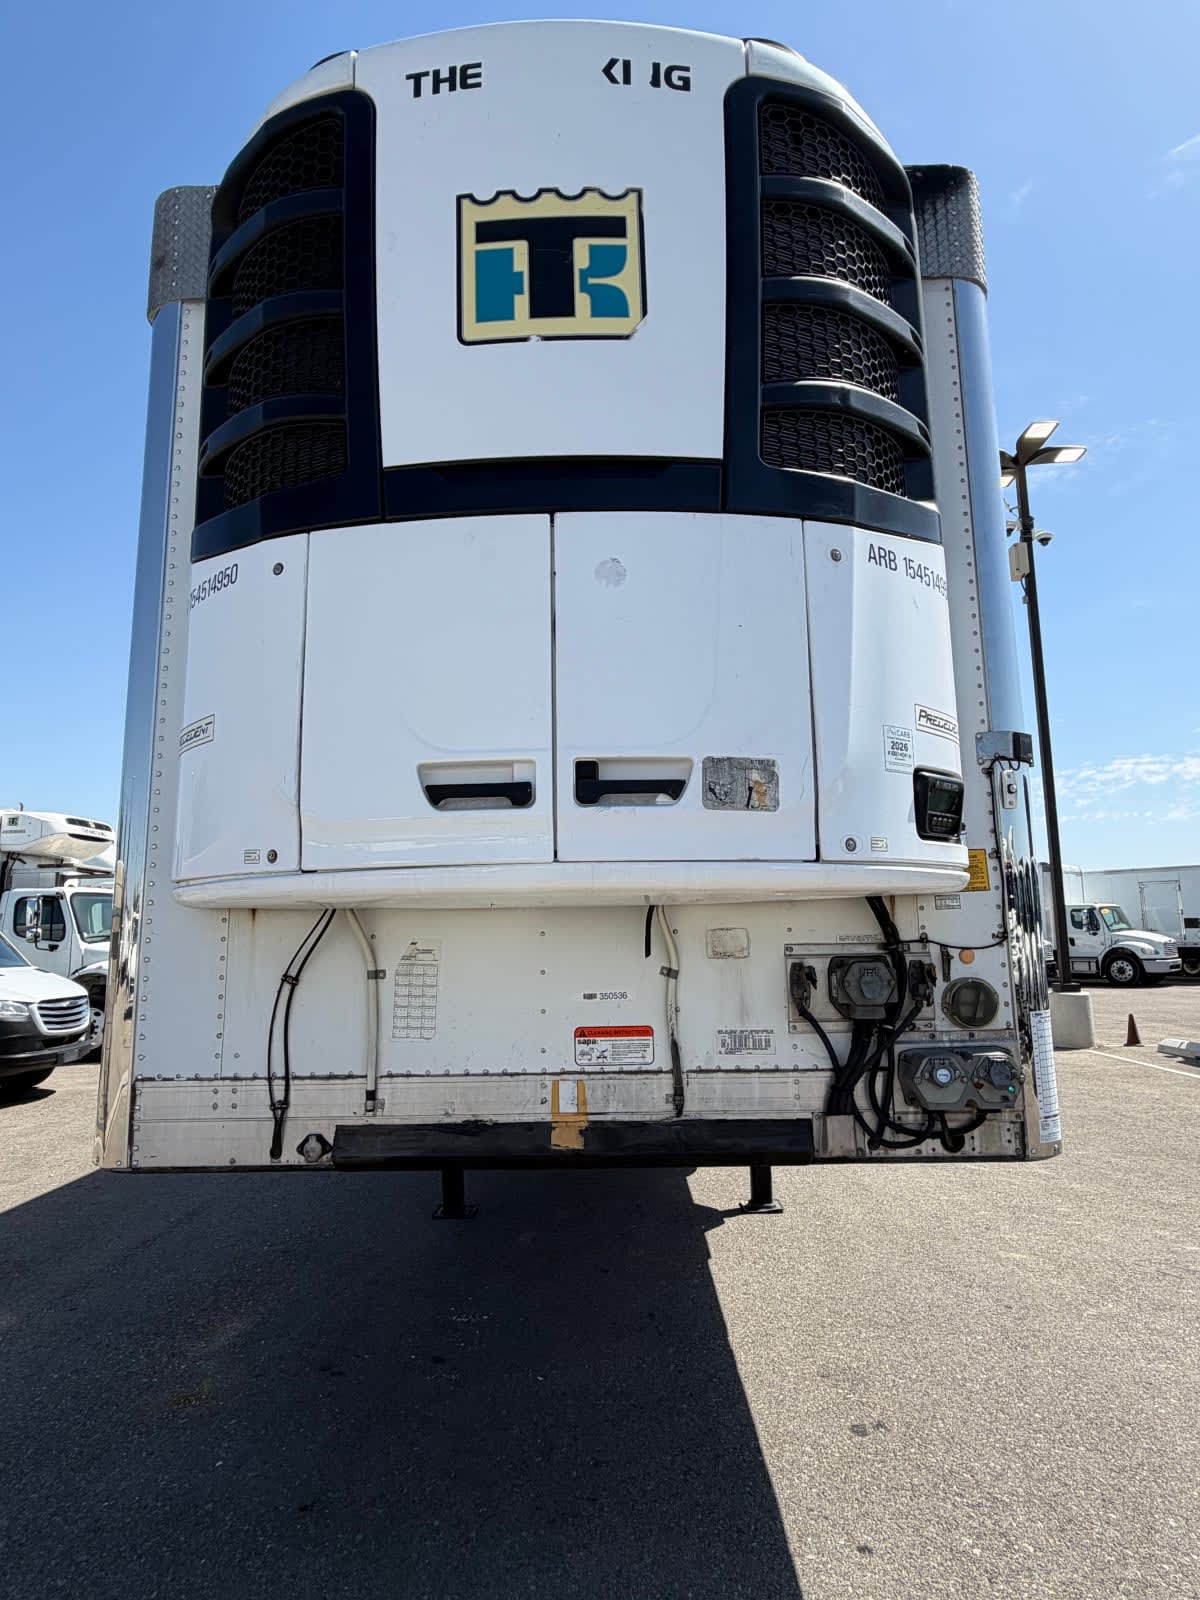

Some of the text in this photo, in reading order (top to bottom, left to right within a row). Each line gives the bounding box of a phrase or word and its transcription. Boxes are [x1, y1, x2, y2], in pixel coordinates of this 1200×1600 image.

[405, 62, 482, 98] THE
[868, 543, 898, 572] ARB
[890, 740, 909, 752] 2026
[599, 991, 628, 1001] 350536
